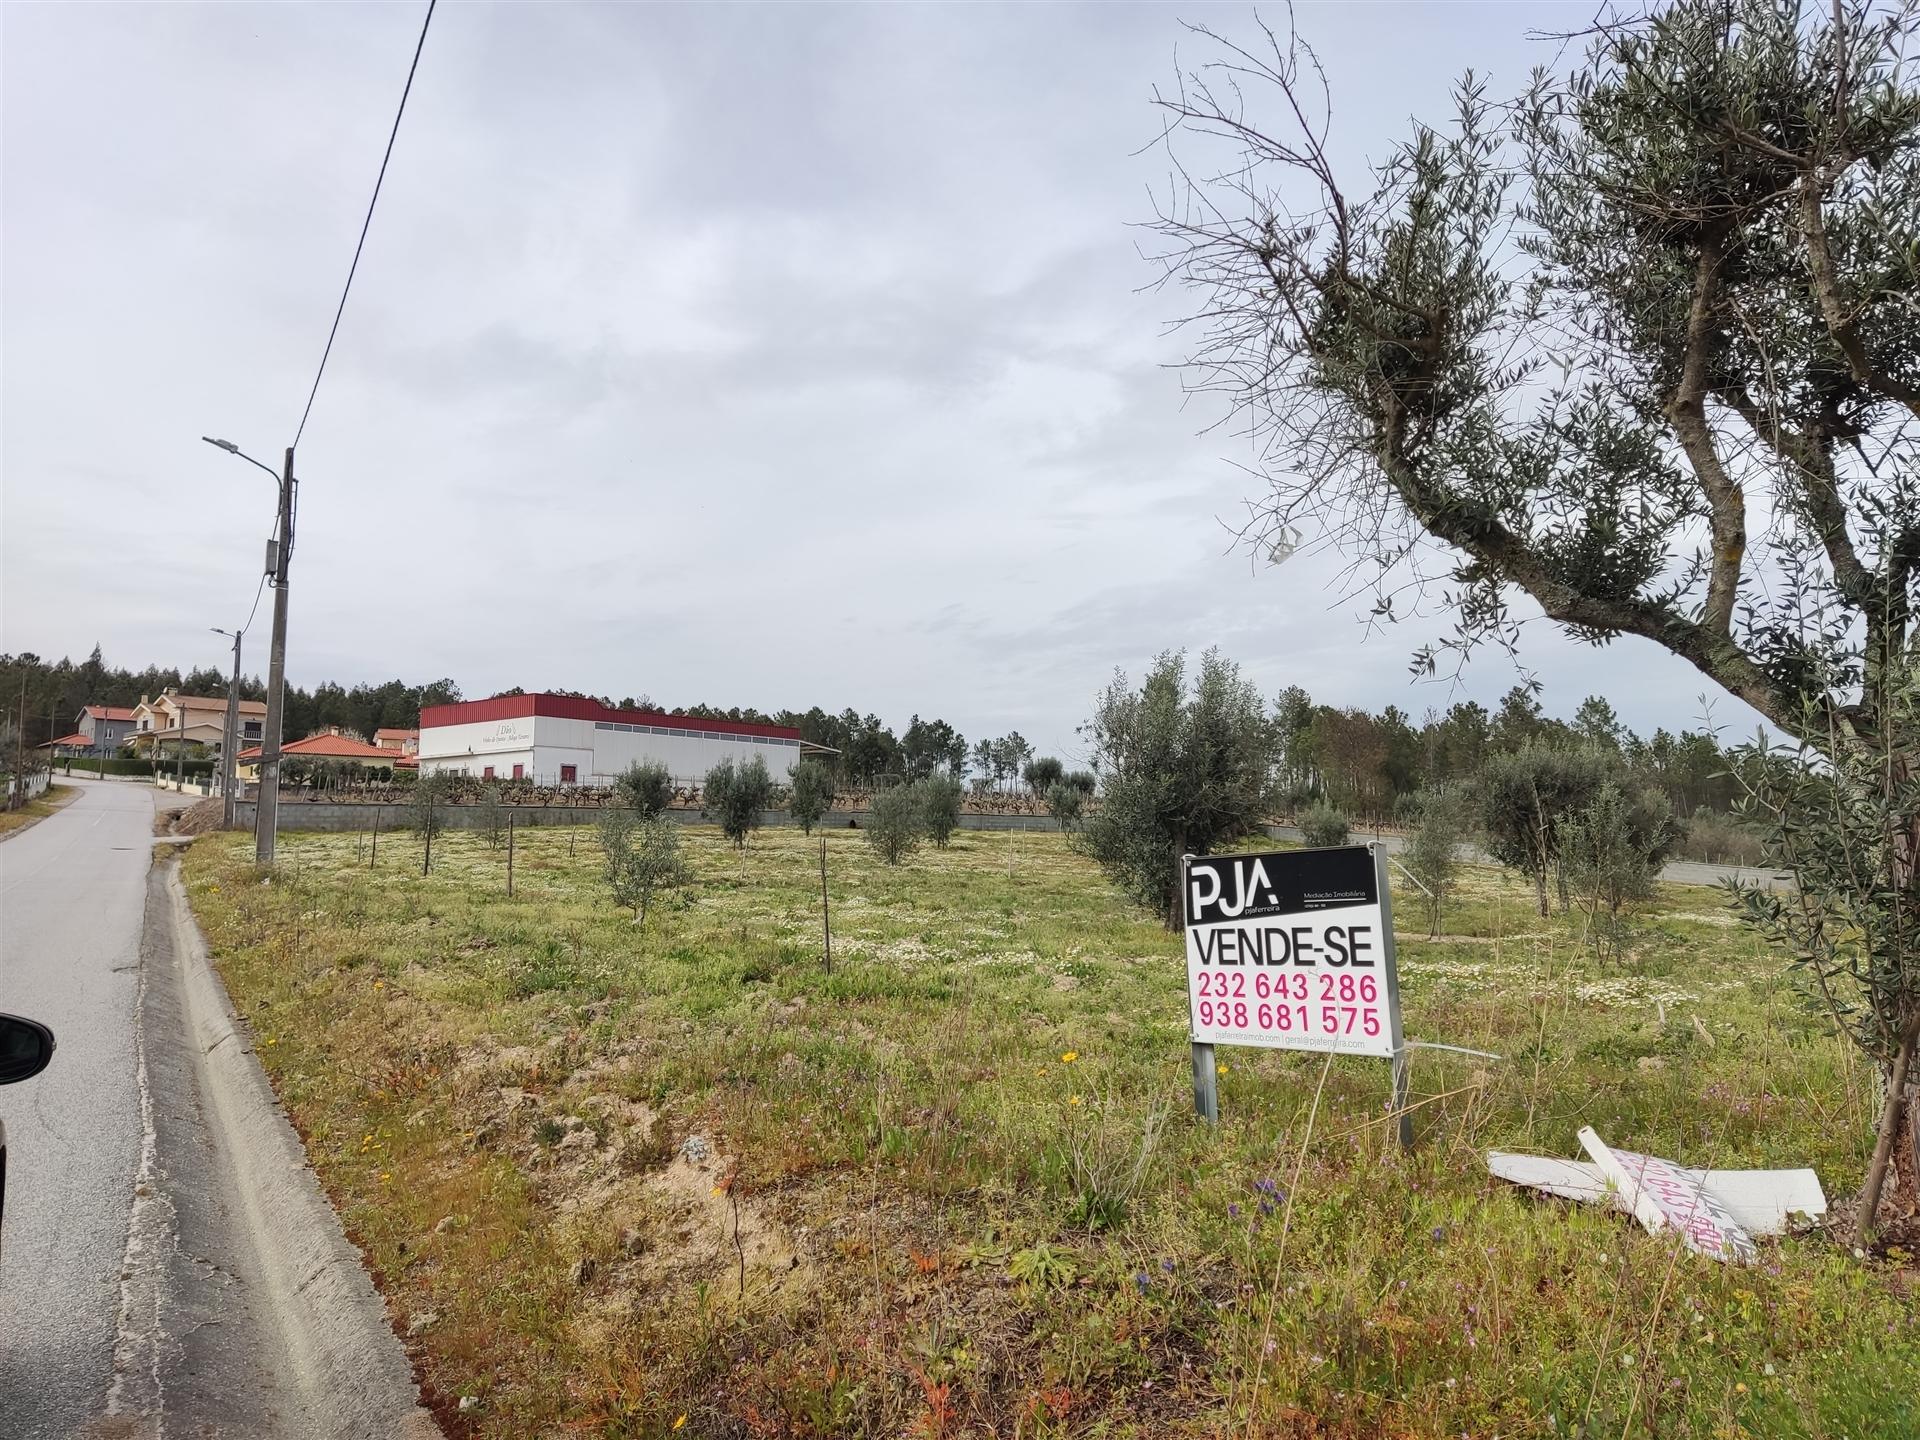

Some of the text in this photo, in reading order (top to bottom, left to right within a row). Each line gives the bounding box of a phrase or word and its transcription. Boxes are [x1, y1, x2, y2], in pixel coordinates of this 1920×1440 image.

[1191, 858, 1279, 920] PJA
[1245, 905, 1280, 916] pjaferreira
[1193, 926, 1374, 967] VENDE-SE
[1198, 972, 1377, 1003] 232 643 286
[1200, 1001, 1381, 1036] 938 681 575
